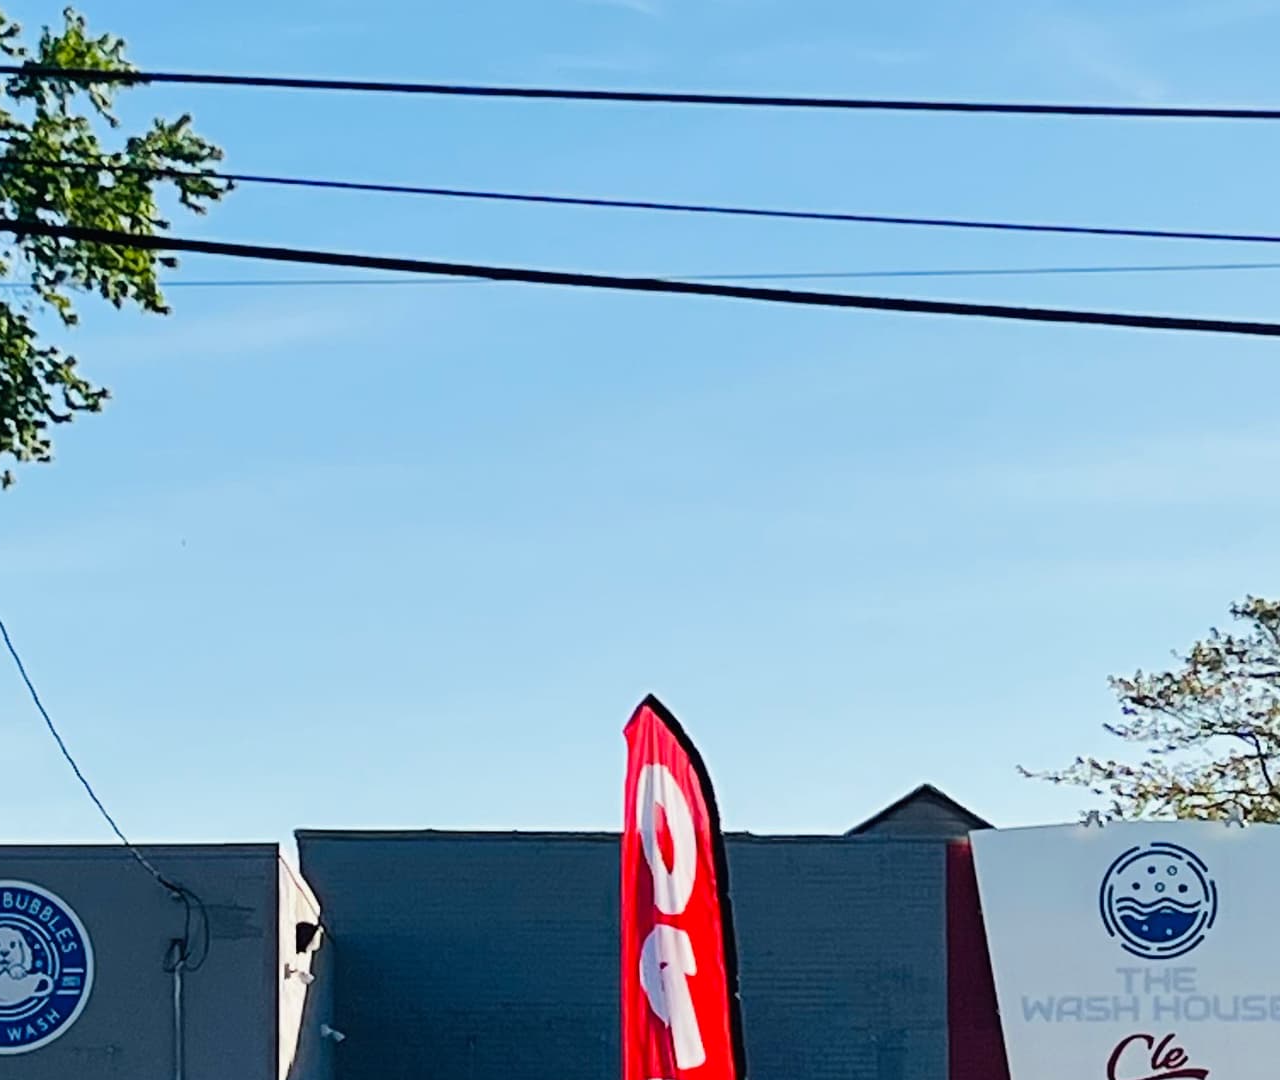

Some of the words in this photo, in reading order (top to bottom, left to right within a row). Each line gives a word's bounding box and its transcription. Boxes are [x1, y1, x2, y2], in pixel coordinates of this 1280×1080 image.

[2, 890, 78, 953] BUBBLES
[1115, 966, 1197, 995] THE
[7, 1007, 61, 1041] WASH
[1021, 995, 1141, 1023] WASH
